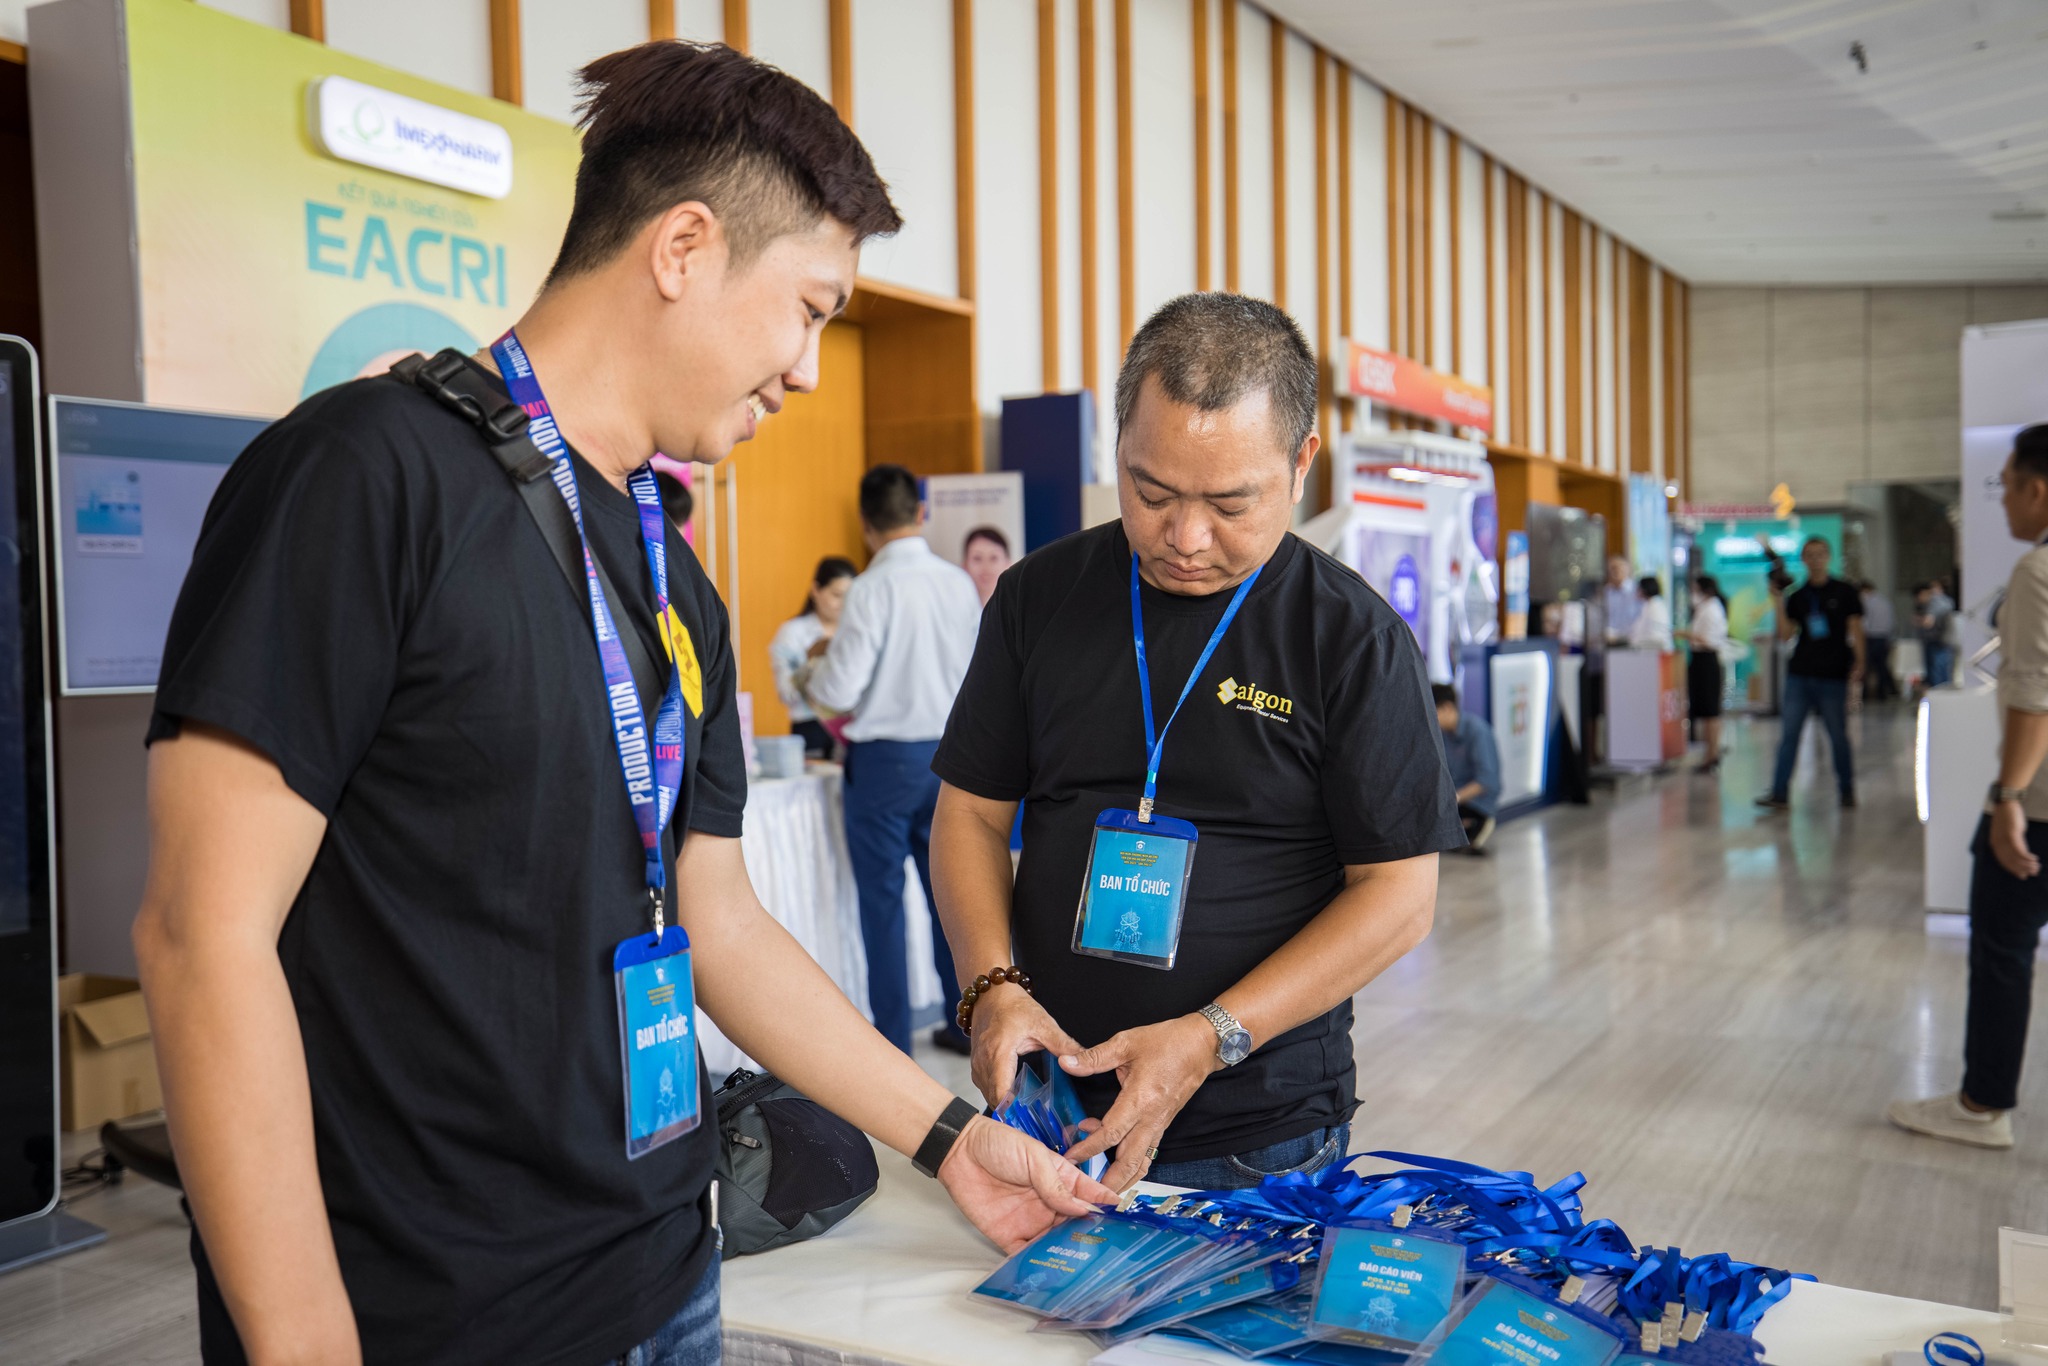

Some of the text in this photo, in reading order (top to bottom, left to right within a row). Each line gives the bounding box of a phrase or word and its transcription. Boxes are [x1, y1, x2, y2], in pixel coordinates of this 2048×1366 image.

[304, 199, 508, 308] EACRI
[1269, 713, 1289, 723] Services
[608, 681, 654, 806] PRODUCTION
[655, 744, 682, 761] LIVE
[1100, 872, 1171, 896] BAN TỔ CHỨC
[636, 1025, 656, 1050] BAN
[1358, 1261, 1423, 1282] BÁO CÁO VIÊN
